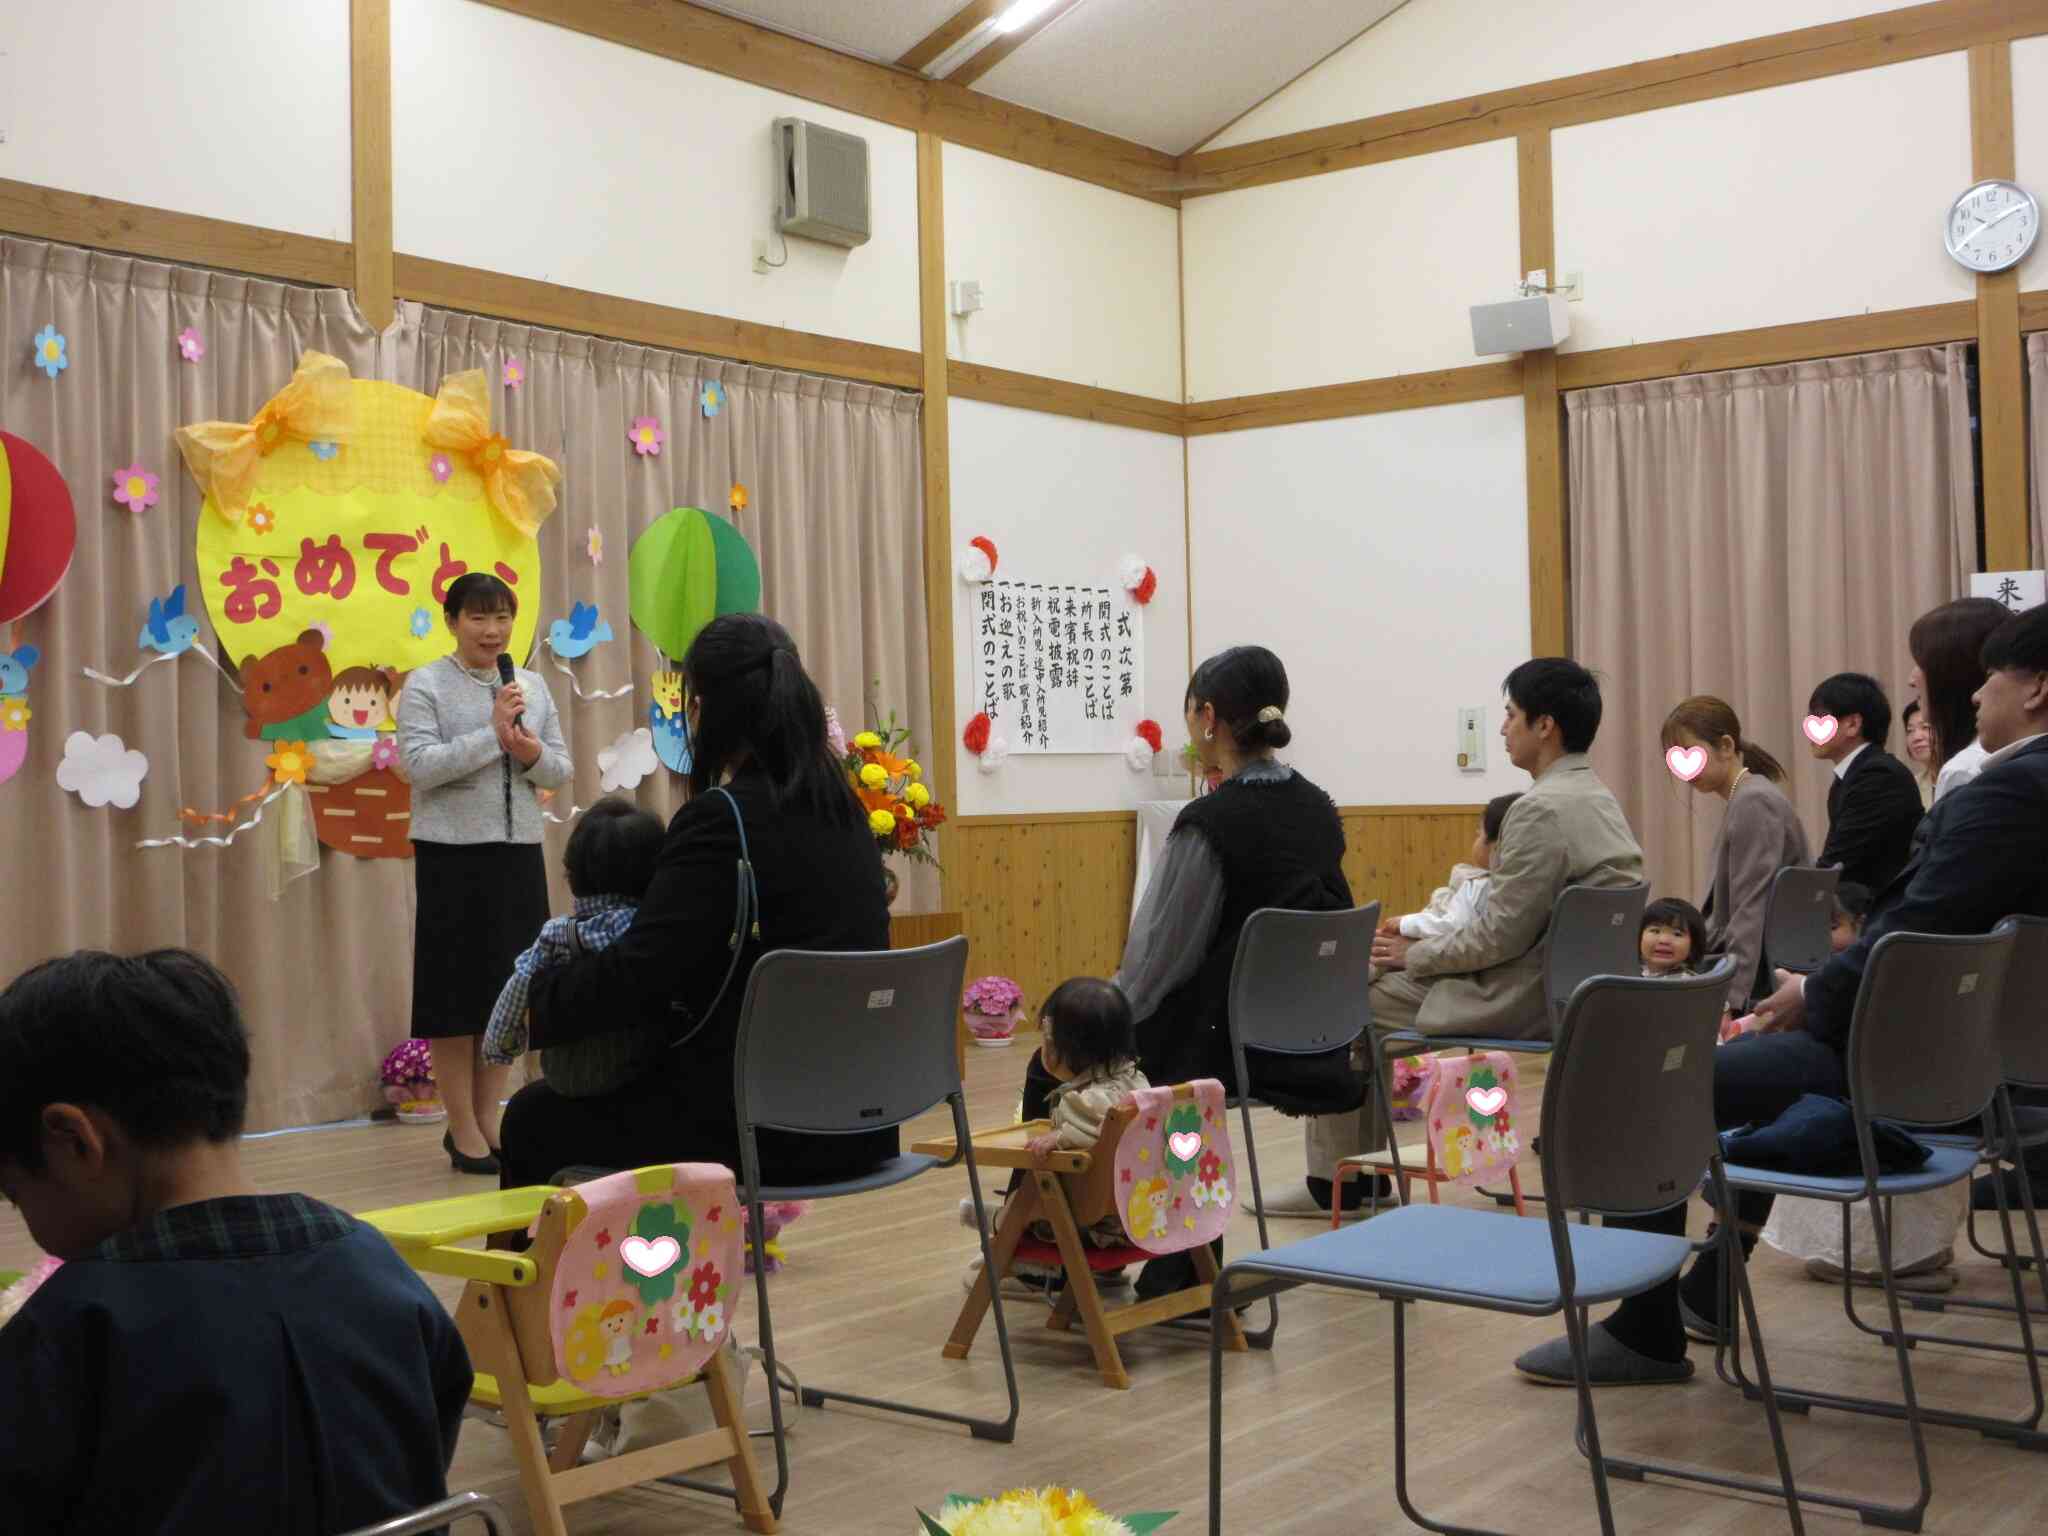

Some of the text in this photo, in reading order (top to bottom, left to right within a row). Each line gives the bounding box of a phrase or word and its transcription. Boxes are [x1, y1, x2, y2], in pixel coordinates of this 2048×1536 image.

[1972, 196, 1980, 208] 11
[1986, 191, 1997, 202] 12
[1960, 207, 1971, 220] 10
[1988, 250, 1997, 262] 6
[1117, 611, 1133, 697] 式次第
